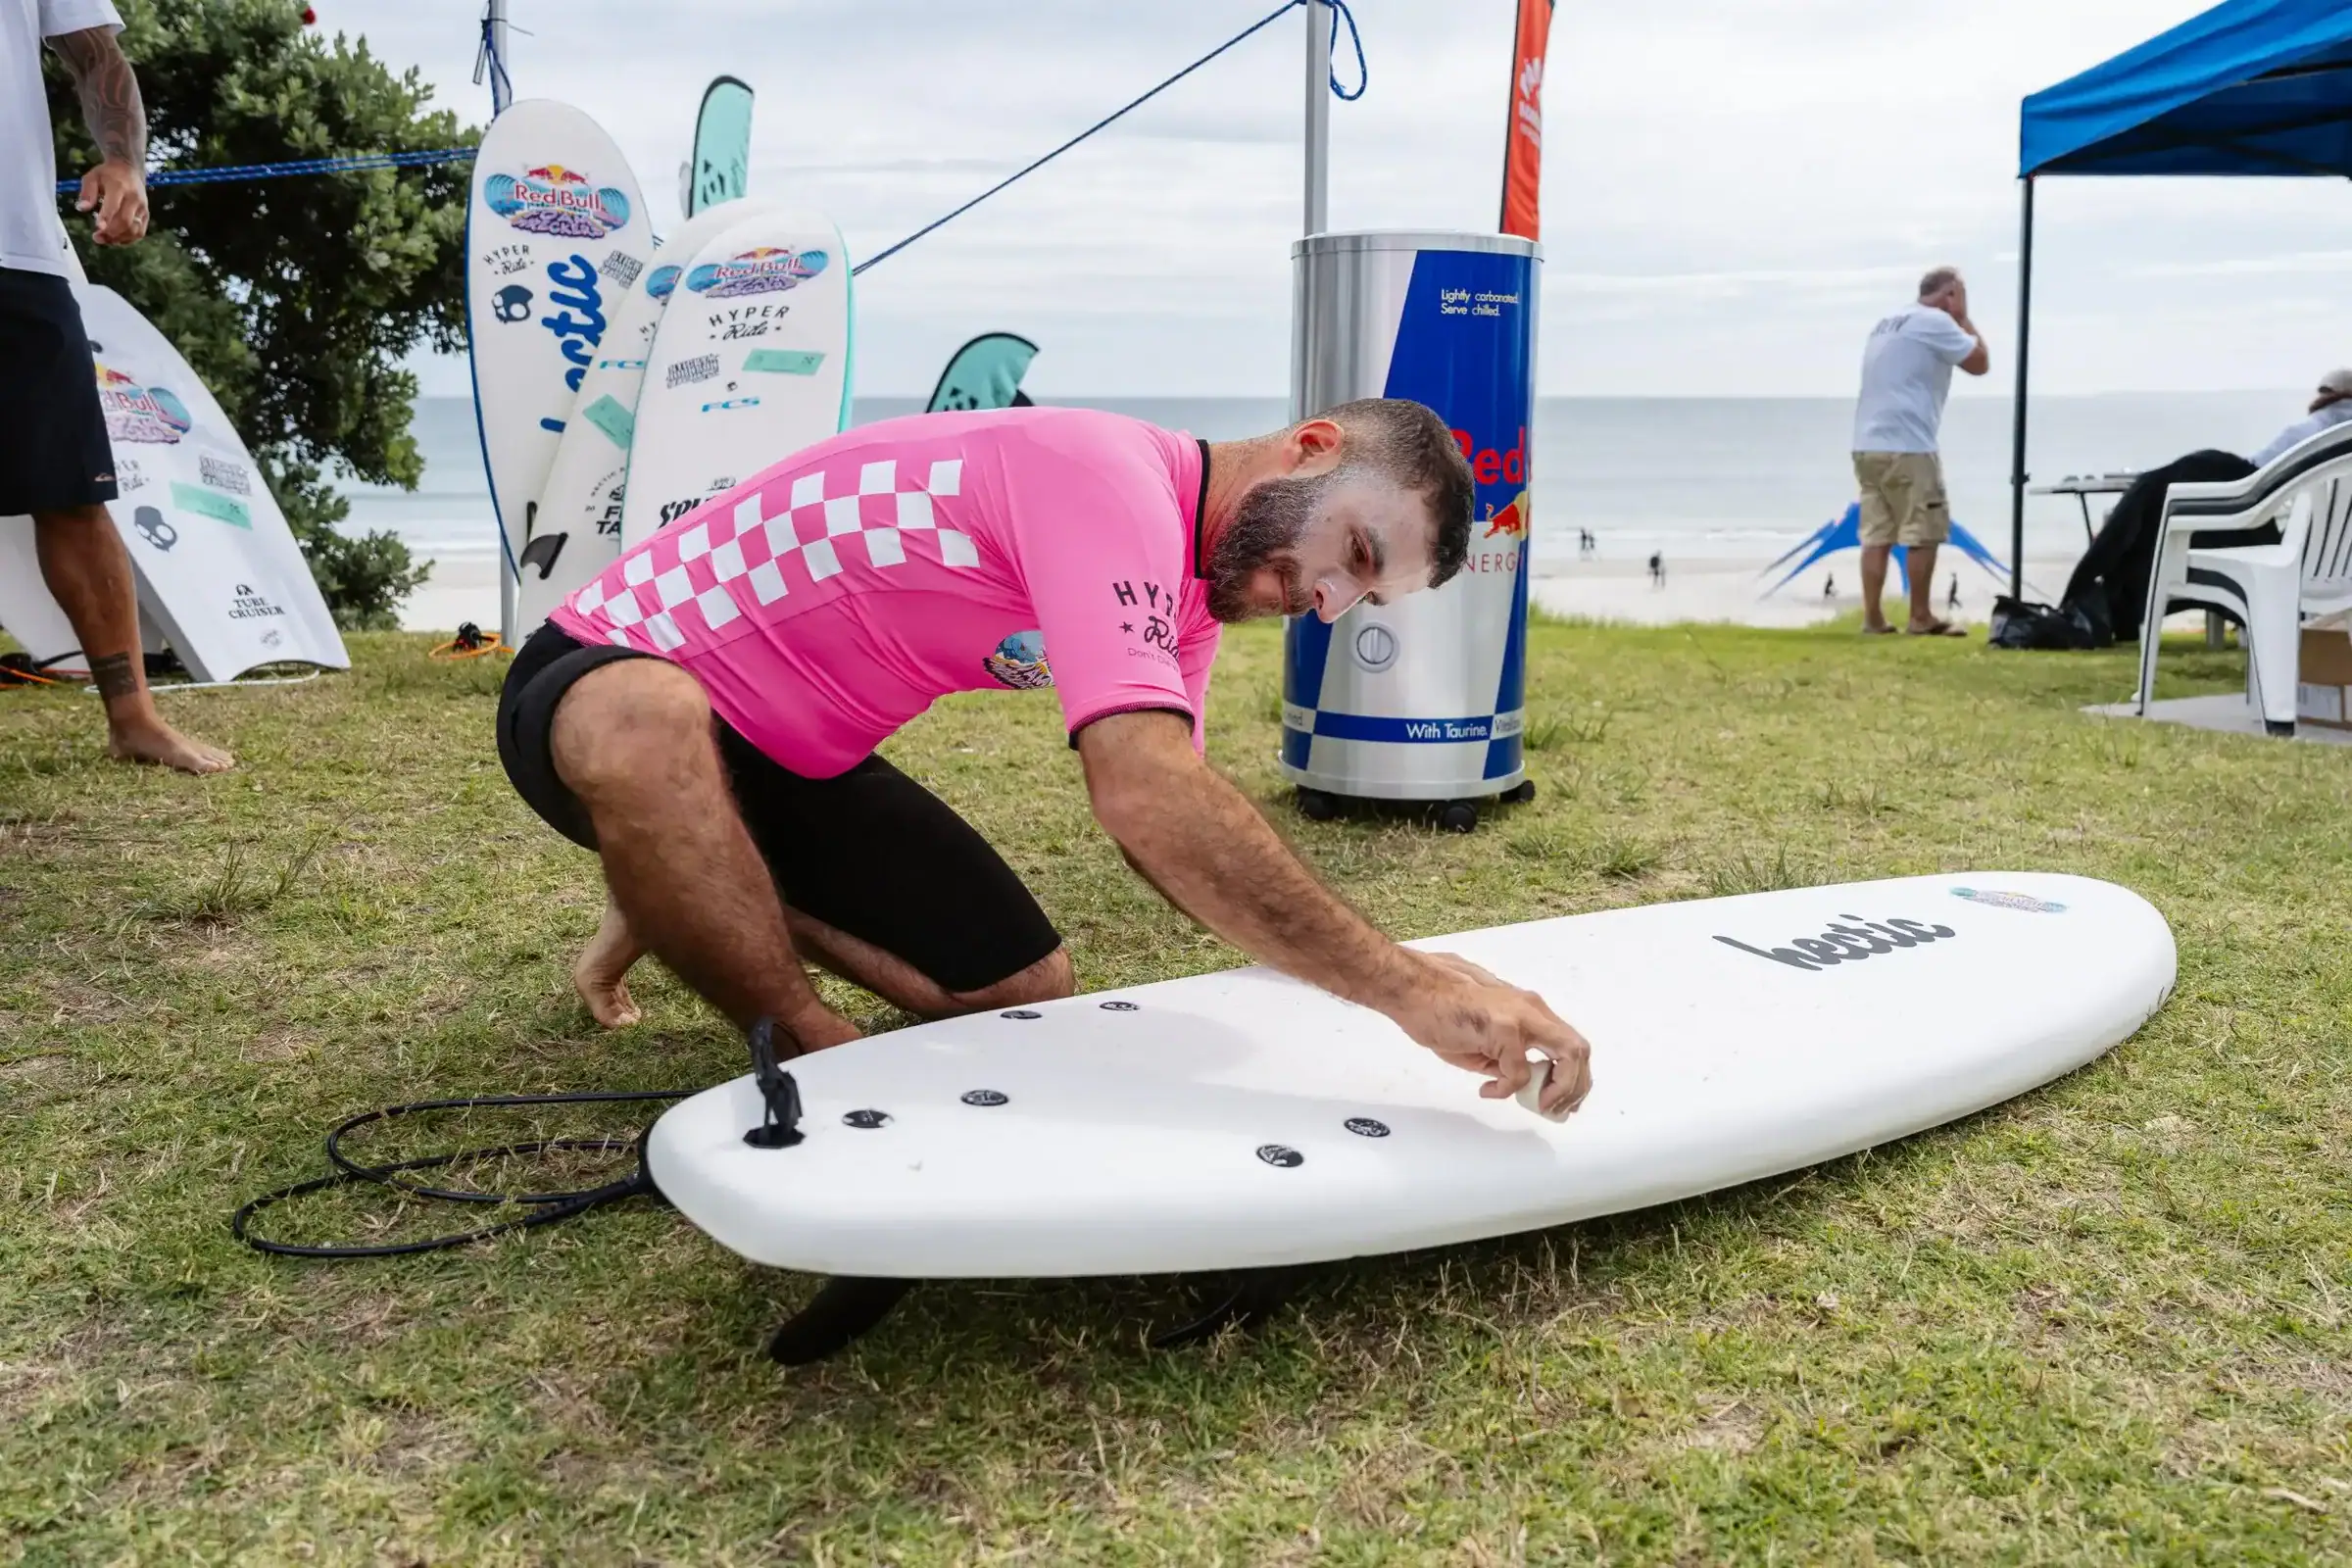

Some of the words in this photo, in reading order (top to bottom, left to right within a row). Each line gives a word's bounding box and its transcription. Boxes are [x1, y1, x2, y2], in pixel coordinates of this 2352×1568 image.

[515, 183, 557, 206] Red
[561, 189, 600, 211] Bull
[483, 244, 530, 265] HYPER
[1441, 288, 1471, 303] Lightly
[1474, 290, 1520, 304] carbonated.
[709, 305, 790, 327] HYPER
[1441, 303, 1468, 315] Serve
[1471, 304, 1501, 317] chilled.
[228, 606, 286, 619] CRUISER
[1405, 723, 1441, 739] With
[1444, 723, 1489, 738] Taurine.
[1712, 913, 1956, 971] hectic
